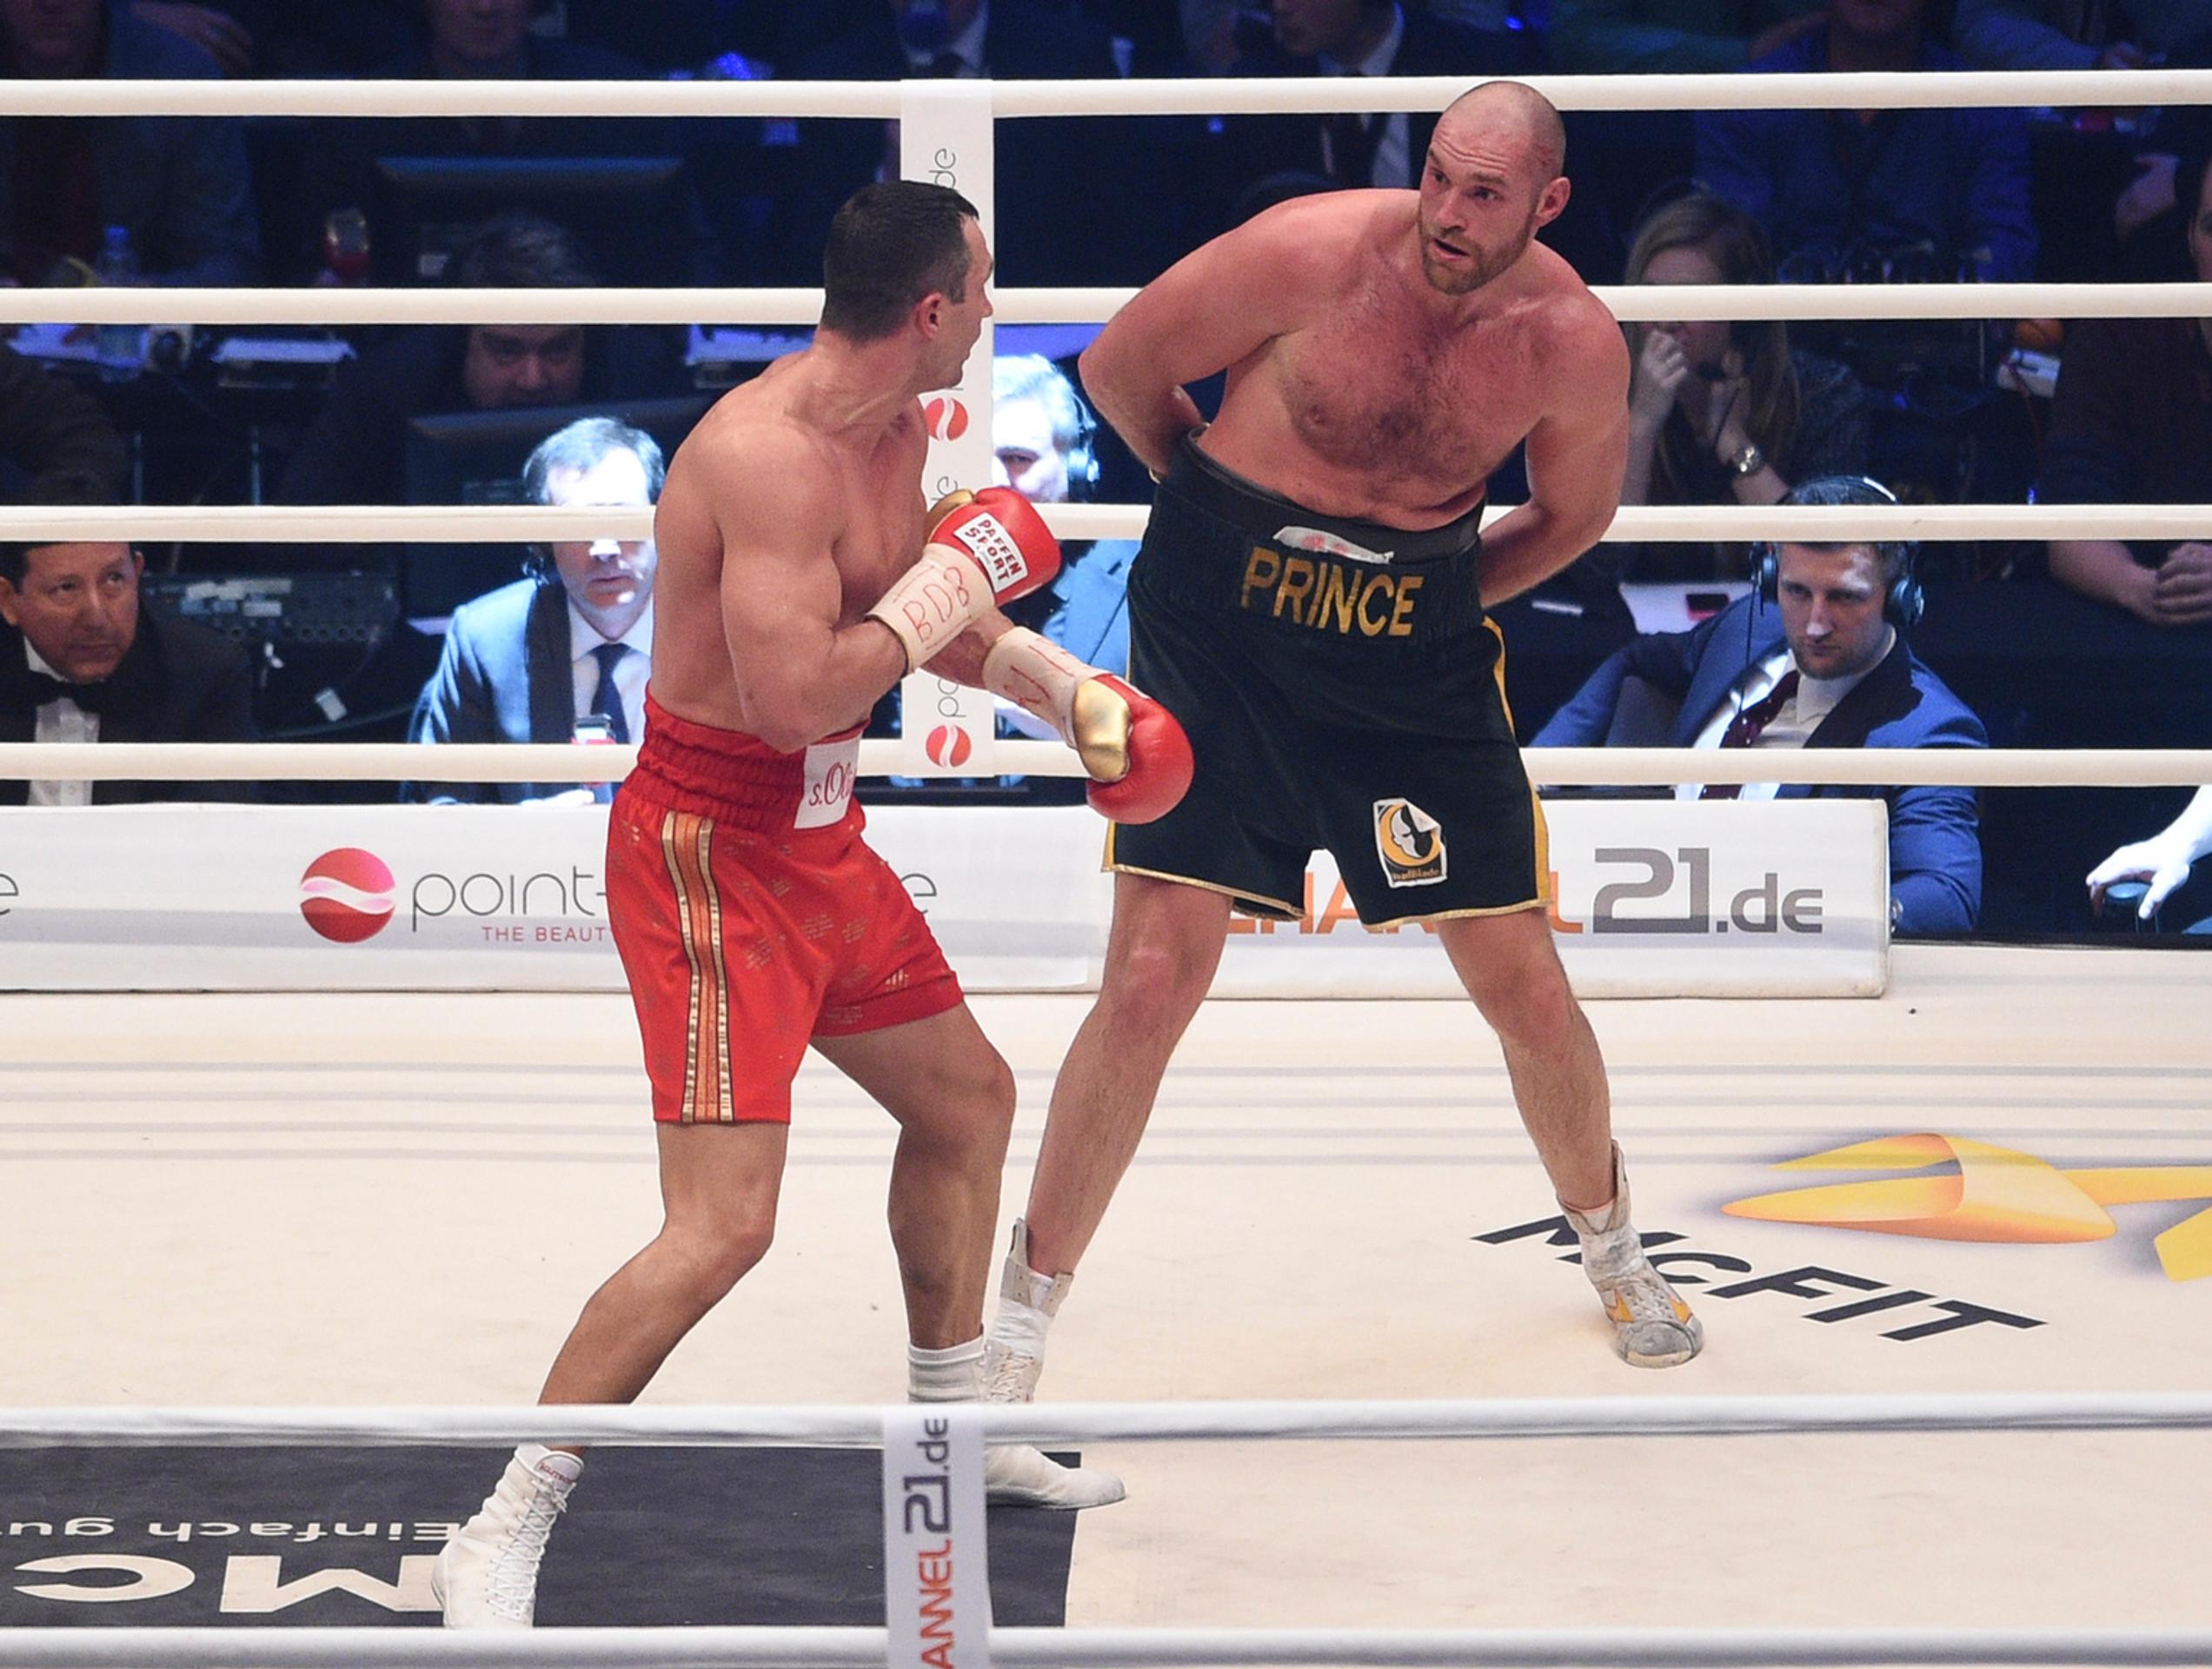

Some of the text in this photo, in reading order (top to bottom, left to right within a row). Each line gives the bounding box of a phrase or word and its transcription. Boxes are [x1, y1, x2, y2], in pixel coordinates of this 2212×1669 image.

[965, 528, 1009, 582] SPORT
[978, 519, 1022, 576] PAFFEN
[1240, 546, 1425, 637] PRINCE
[482, 926, 610, 942] THE BEAUT
[0, 1517, 461, 1542] Einfach gu
